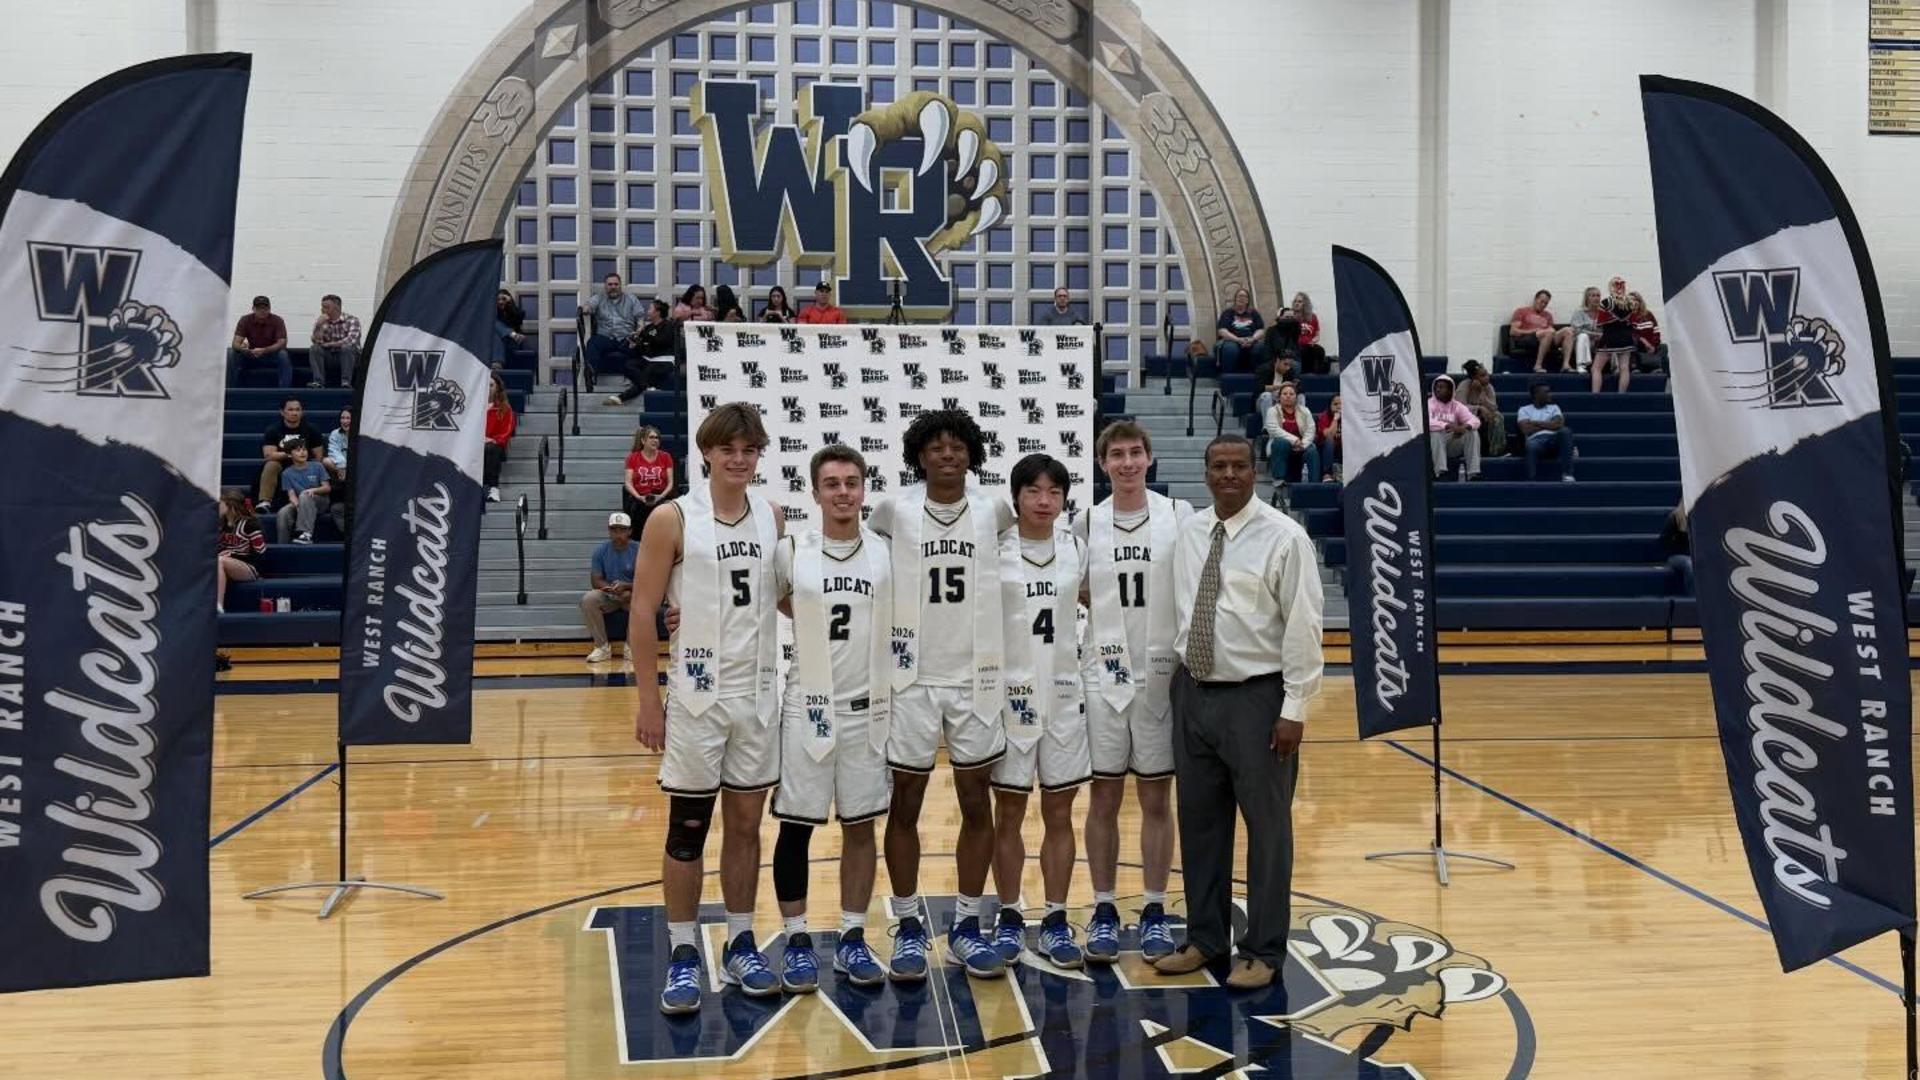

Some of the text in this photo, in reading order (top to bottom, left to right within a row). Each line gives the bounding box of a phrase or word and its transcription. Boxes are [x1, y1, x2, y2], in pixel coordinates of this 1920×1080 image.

[1194, 184, 1244, 305] RELEVANC
[735, 332, 760, 340] WEST
[737, 339, 766, 347] RANCH
[817, 333, 842, 341] WEST
[977, 333, 1000, 341] WEST
[819, 340, 848, 348] RANCH
[899, 340, 928, 349] RANCH
[697, 366, 721, 374] WEST
[860, 368, 884, 376] WEST
[978, 402, 1000, 410] WEST
[819, 410, 848, 418] RANCH
[779, 437, 802, 445] WEST
[860, 437, 883, 445] WEST
[977, 470, 1000, 478] WEST
[921, 539, 975, 558] ILDCAT
[1114, 546, 1152, 562] LDCA
[730, 569, 752, 607] 5
[823, 576, 874, 599] LDCAT
[928, 566, 966, 604] 15
[1026, 581, 1057, 598] LDC
[1118, 572, 1146, 607] 11
[1408, 530, 1426, 653] WEST RANCH
[362, 538, 388, 668] WEST RANCH
[383, 482, 453, 724] Wildcats
[1363, 481, 1410, 713] Wildcats
[829, 603, 852, 641] 2
[1032, 608, 1055, 644] 4
[891, 626, 914, 638] 2026
[684, 647, 713, 659] 2026
[1100, 645, 1124, 656] 2026
[0, 602, 26, 731] RANCH
[1007, 686, 1033, 696] 2026
[806, 695, 829, 706] 2026
[1723, 500, 1850, 909] Wildcats
[1846, 590, 1897, 817] WEST RANCH
[39, 492, 164, 942] Wildcats
